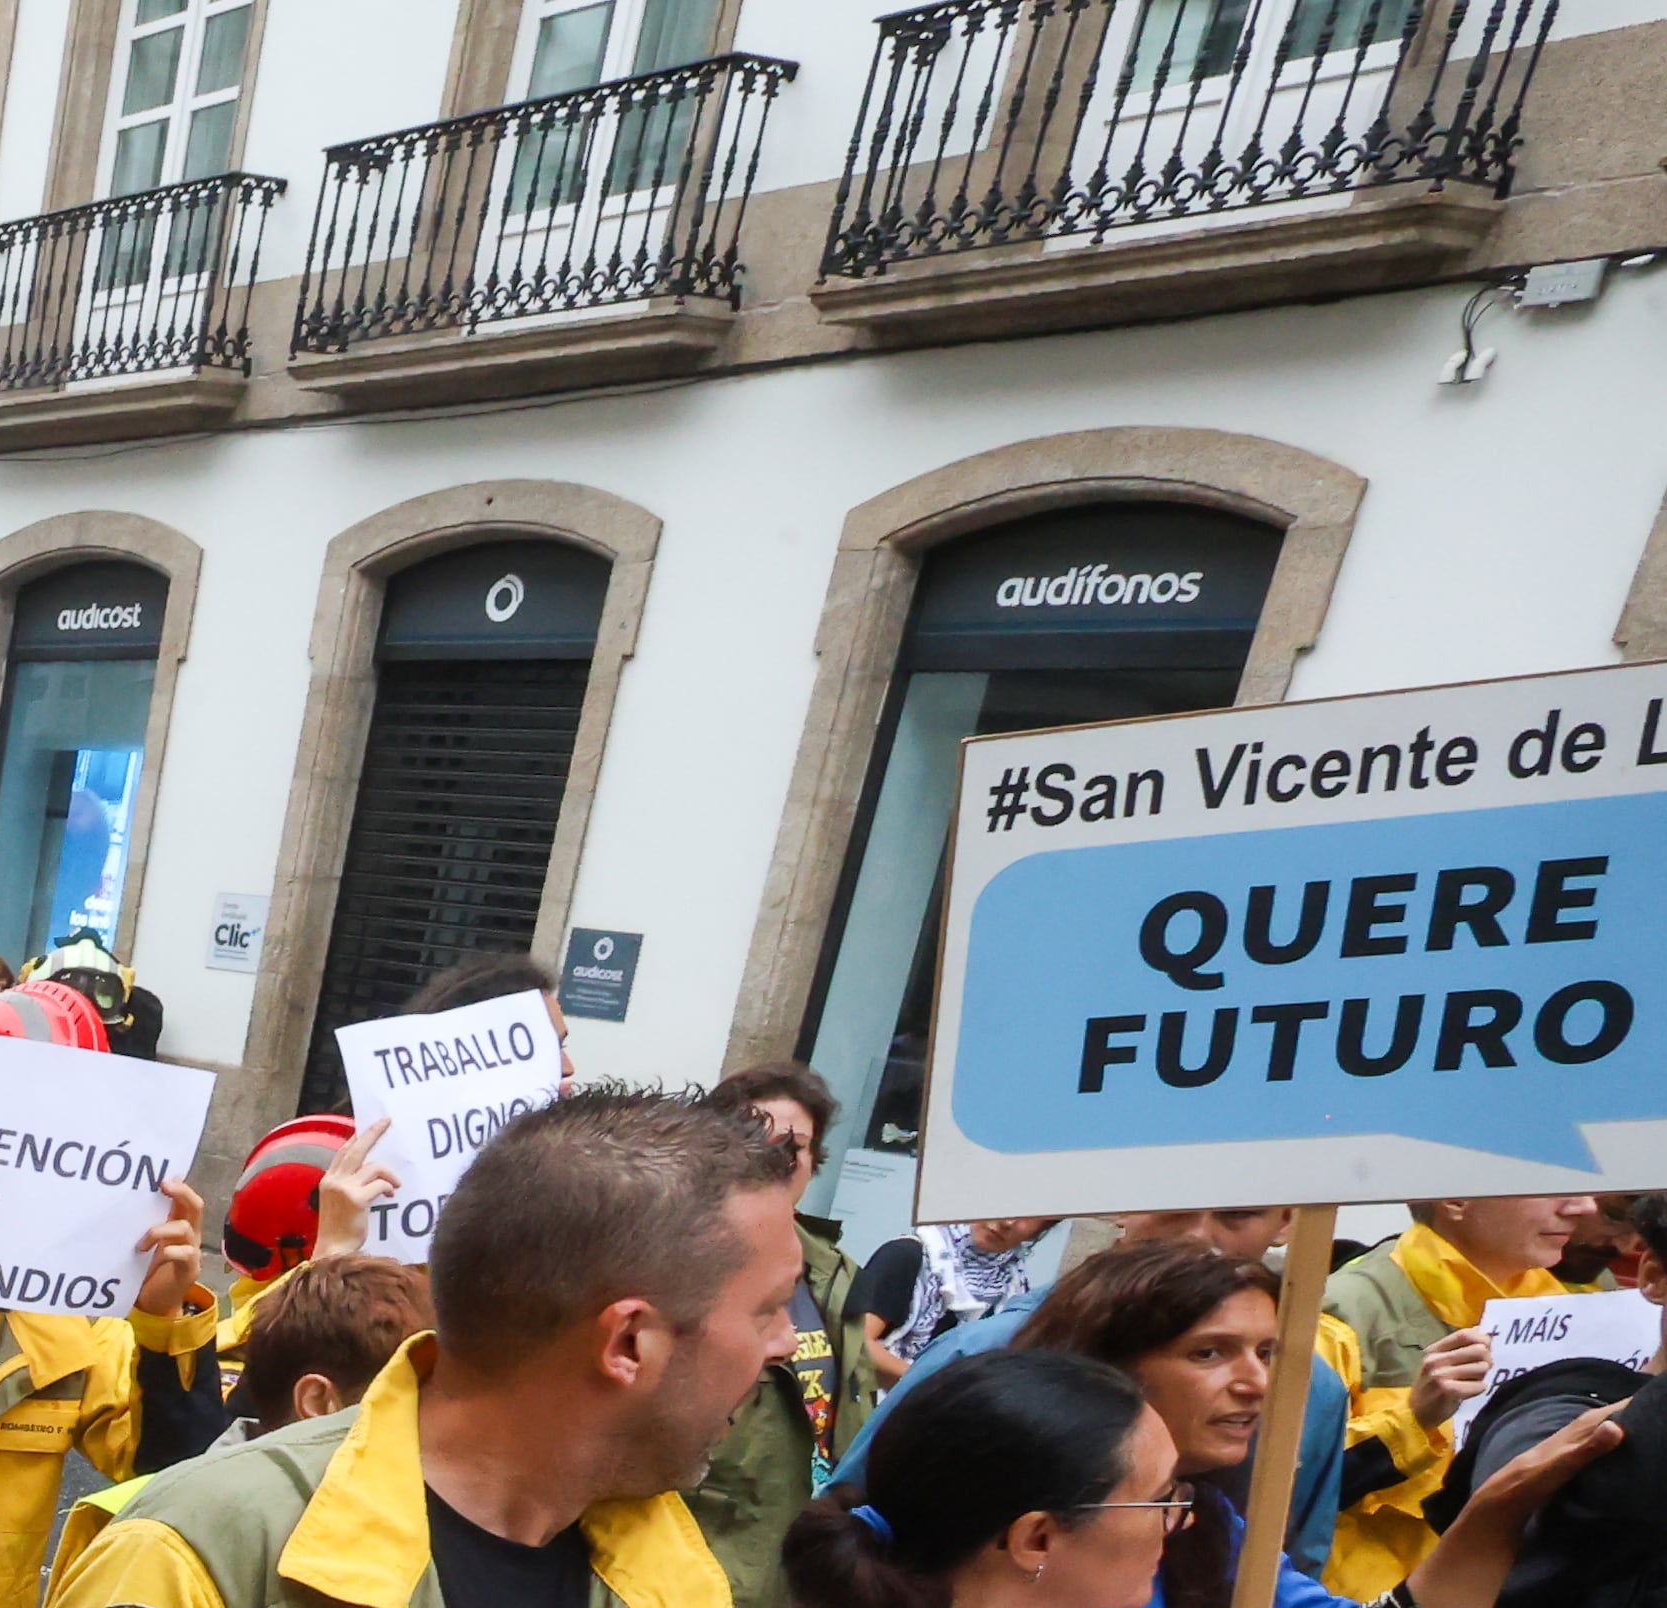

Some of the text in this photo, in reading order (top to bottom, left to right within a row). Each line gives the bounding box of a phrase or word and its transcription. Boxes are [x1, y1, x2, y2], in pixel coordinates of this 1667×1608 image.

[996, 563, 1204, 608] audífonos
[57, 602, 142, 631] audicost
[987, 762, 1164, 833] #San
[1195, 725, 1478, 809] Vicente
[1507, 709, 1606, 779] de
[214, 923, 251, 949] Clic
[1139, 856, 1609, 991] QUERE
[373, 1022, 535, 1089] TRABALLO
[1078, 980, 1634, 1094] FUTURO
[1505, 1308, 1573, 1345] MÁIS
